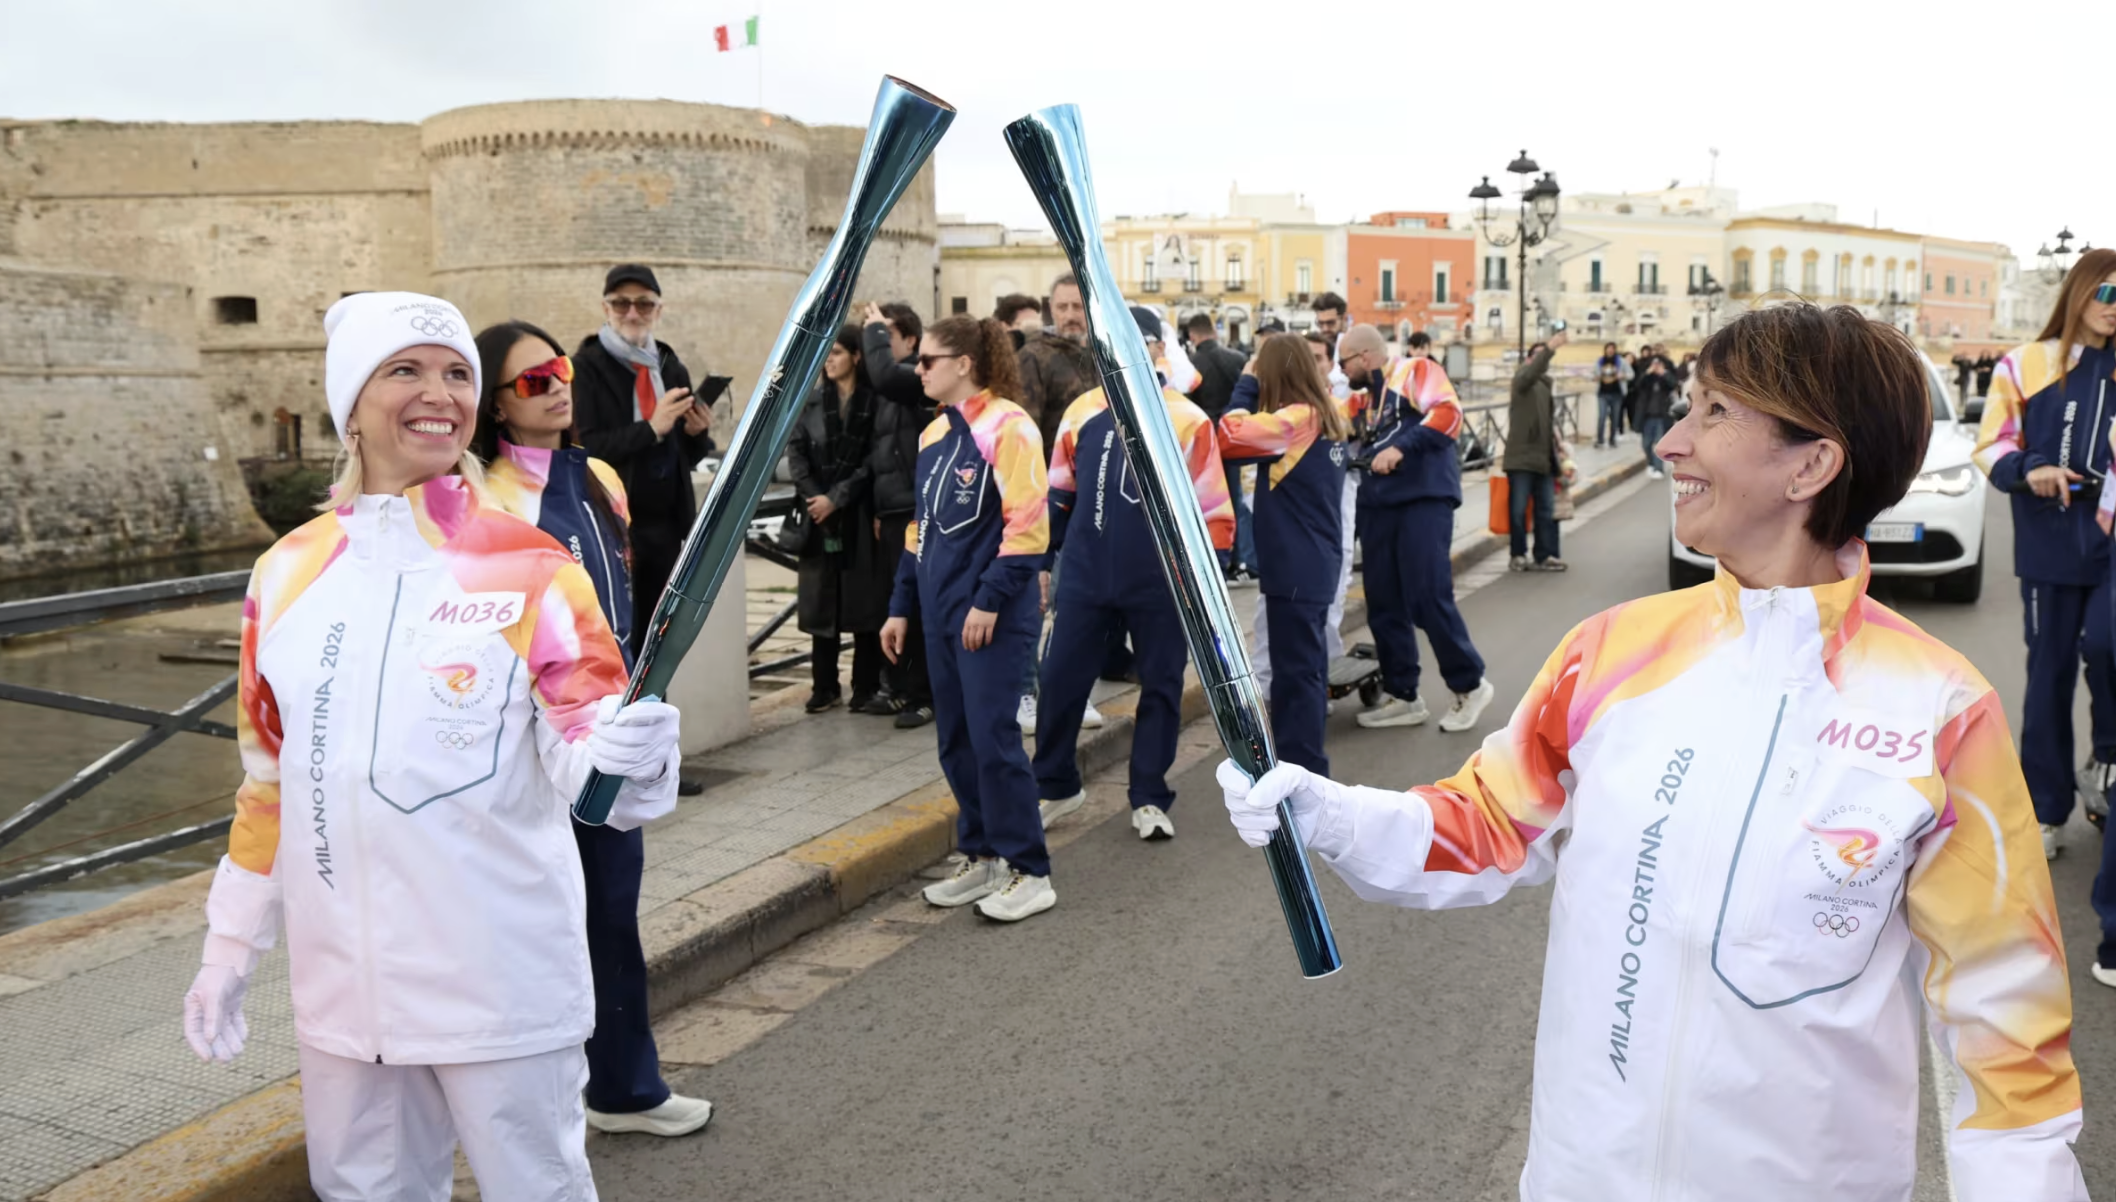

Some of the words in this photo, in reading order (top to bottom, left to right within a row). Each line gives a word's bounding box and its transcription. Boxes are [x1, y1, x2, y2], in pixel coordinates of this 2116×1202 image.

[1097, 450, 1110, 490] CORTINA
[1094, 490, 1105, 530] MILANO
[568, 535, 585, 567] 026
[430, 600, 516, 624] M036
[320, 621, 346, 669] 2026
[458, 677, 495, 709] OLIMPICA
[310, 676, 335, 782] CORTINA
[456, 718, 488, 726] CORTINA
[1816, 719, 1928, 763] M035
[311, 787, 335, 890] MILANO
[1820, 804, 1873, 825] VIAGGIO
[1878, 813, 1903, 845] DELLA
[1812, 840, 1842, 885] FIAMMA
[1848, 850, 1901, 888] OLIMPICA
[1608, 952, 1642, 1083] MILANO
[1625, 814, 1670, 947] CORTINA
[1655, 748, 1695, 806] 2026
[1803, 893, 1842, 904] MILANO
[1841, 895, 1878, 909] CORTINA
[1830, 904, 1849, 913] 2026
